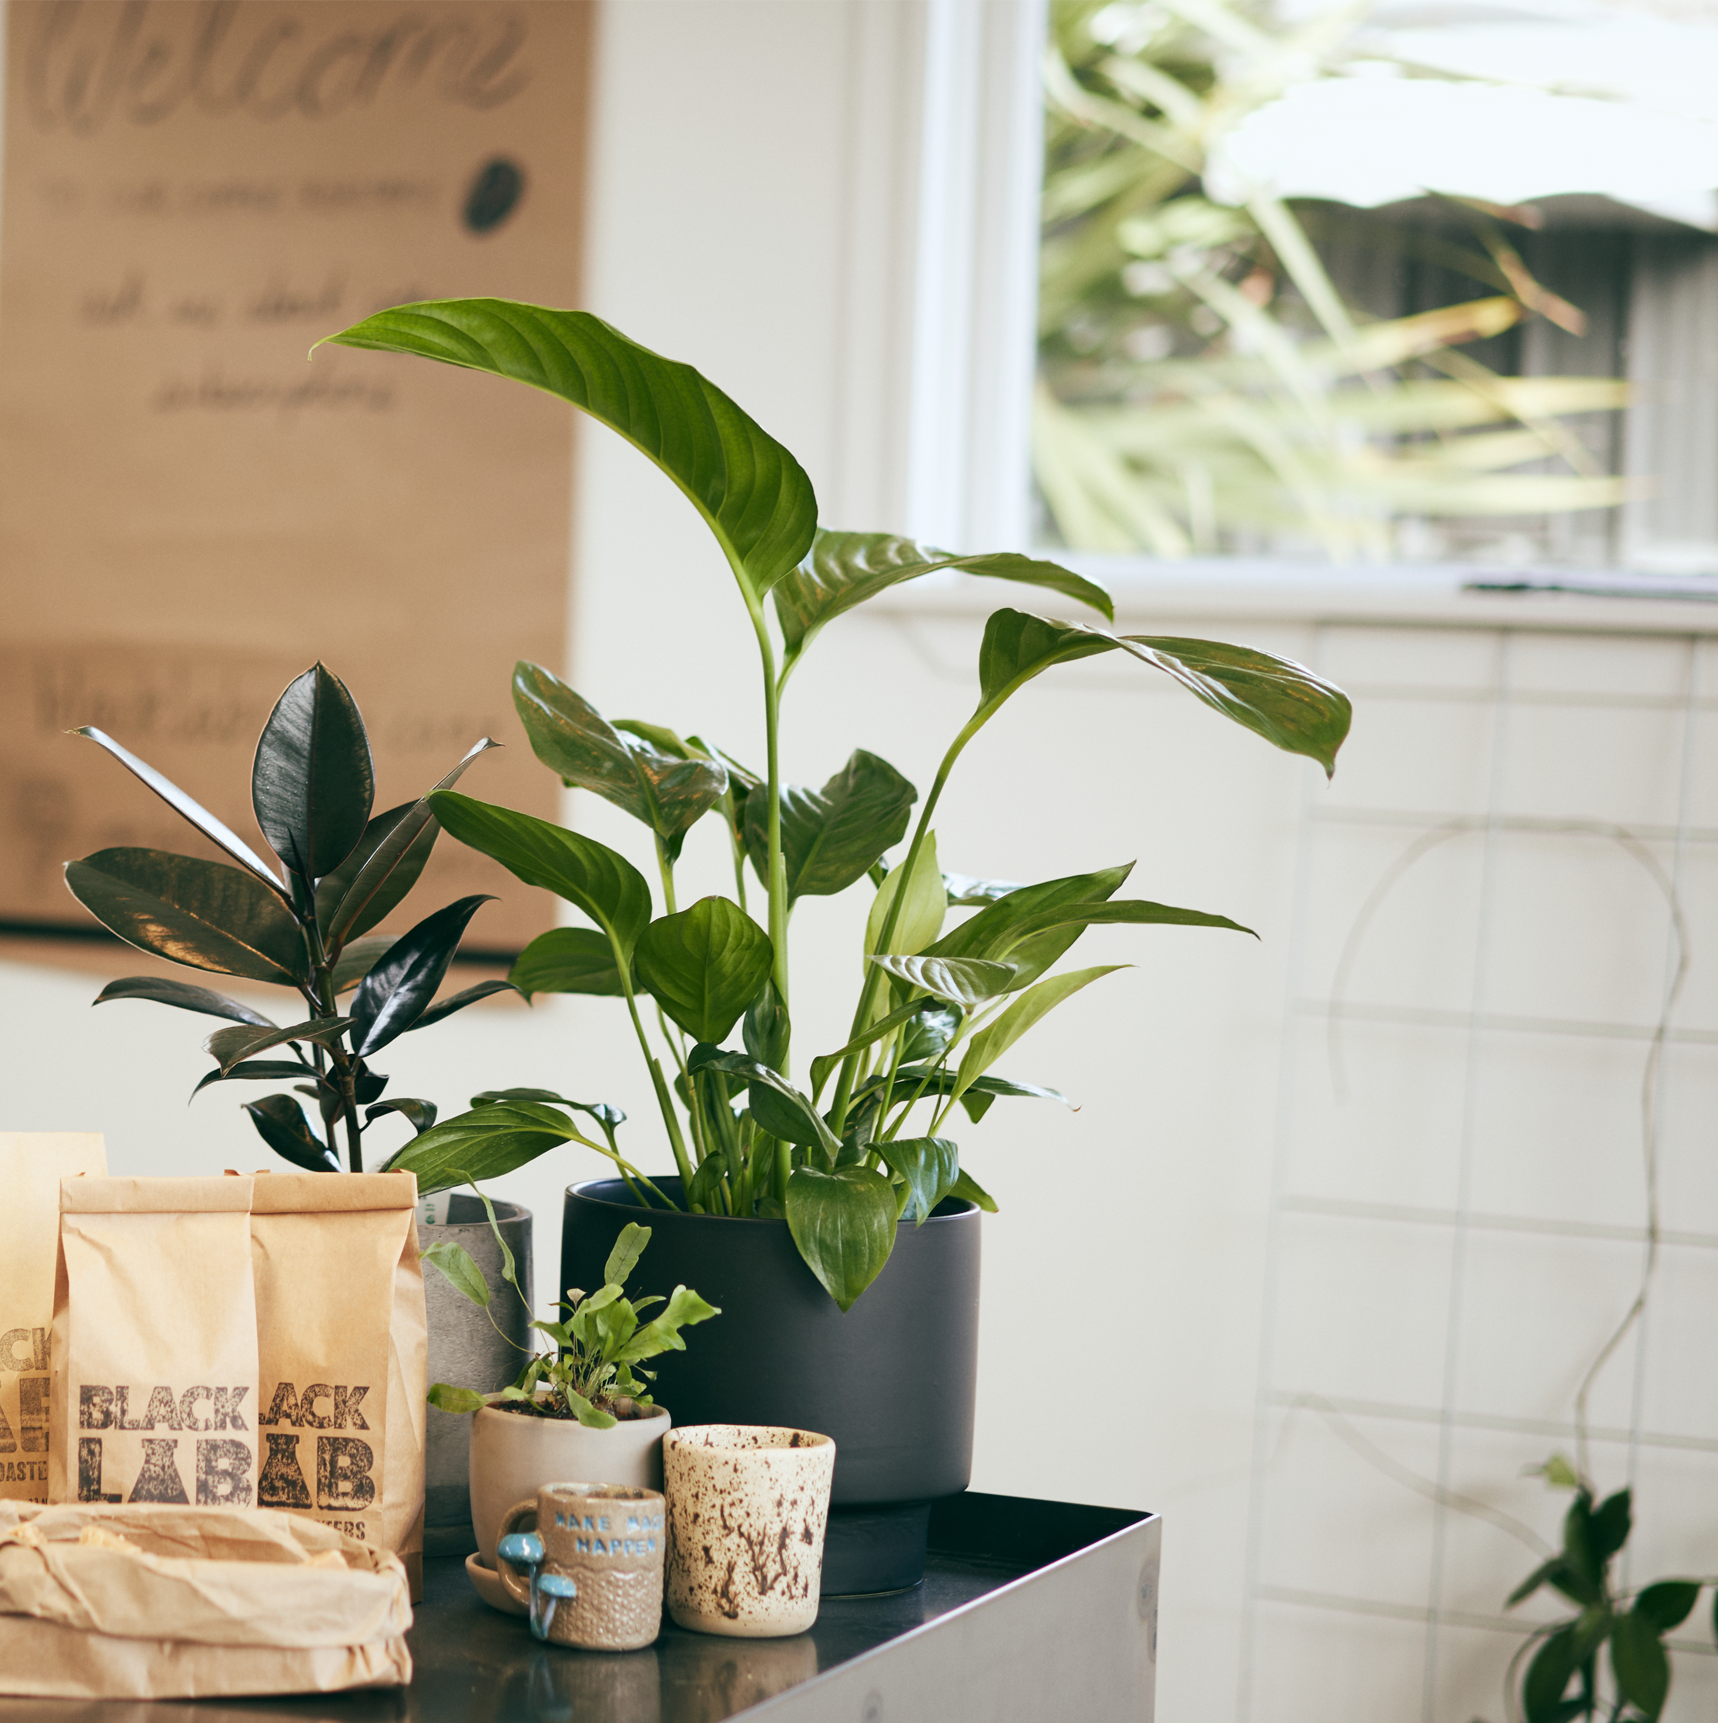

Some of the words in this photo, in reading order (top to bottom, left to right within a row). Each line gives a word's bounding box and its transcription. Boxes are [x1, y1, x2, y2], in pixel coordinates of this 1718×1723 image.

[24, 0, 536, 137] Welcome
[79, 1385, 250, 1431] BLACK
[258, 1382, 370, 1430] ACK
[257, 1433, 376, 1511] AB
[555, 1512, 610, 1532] MAKE
[576, 1538, 655, 1557] HAPPEN
